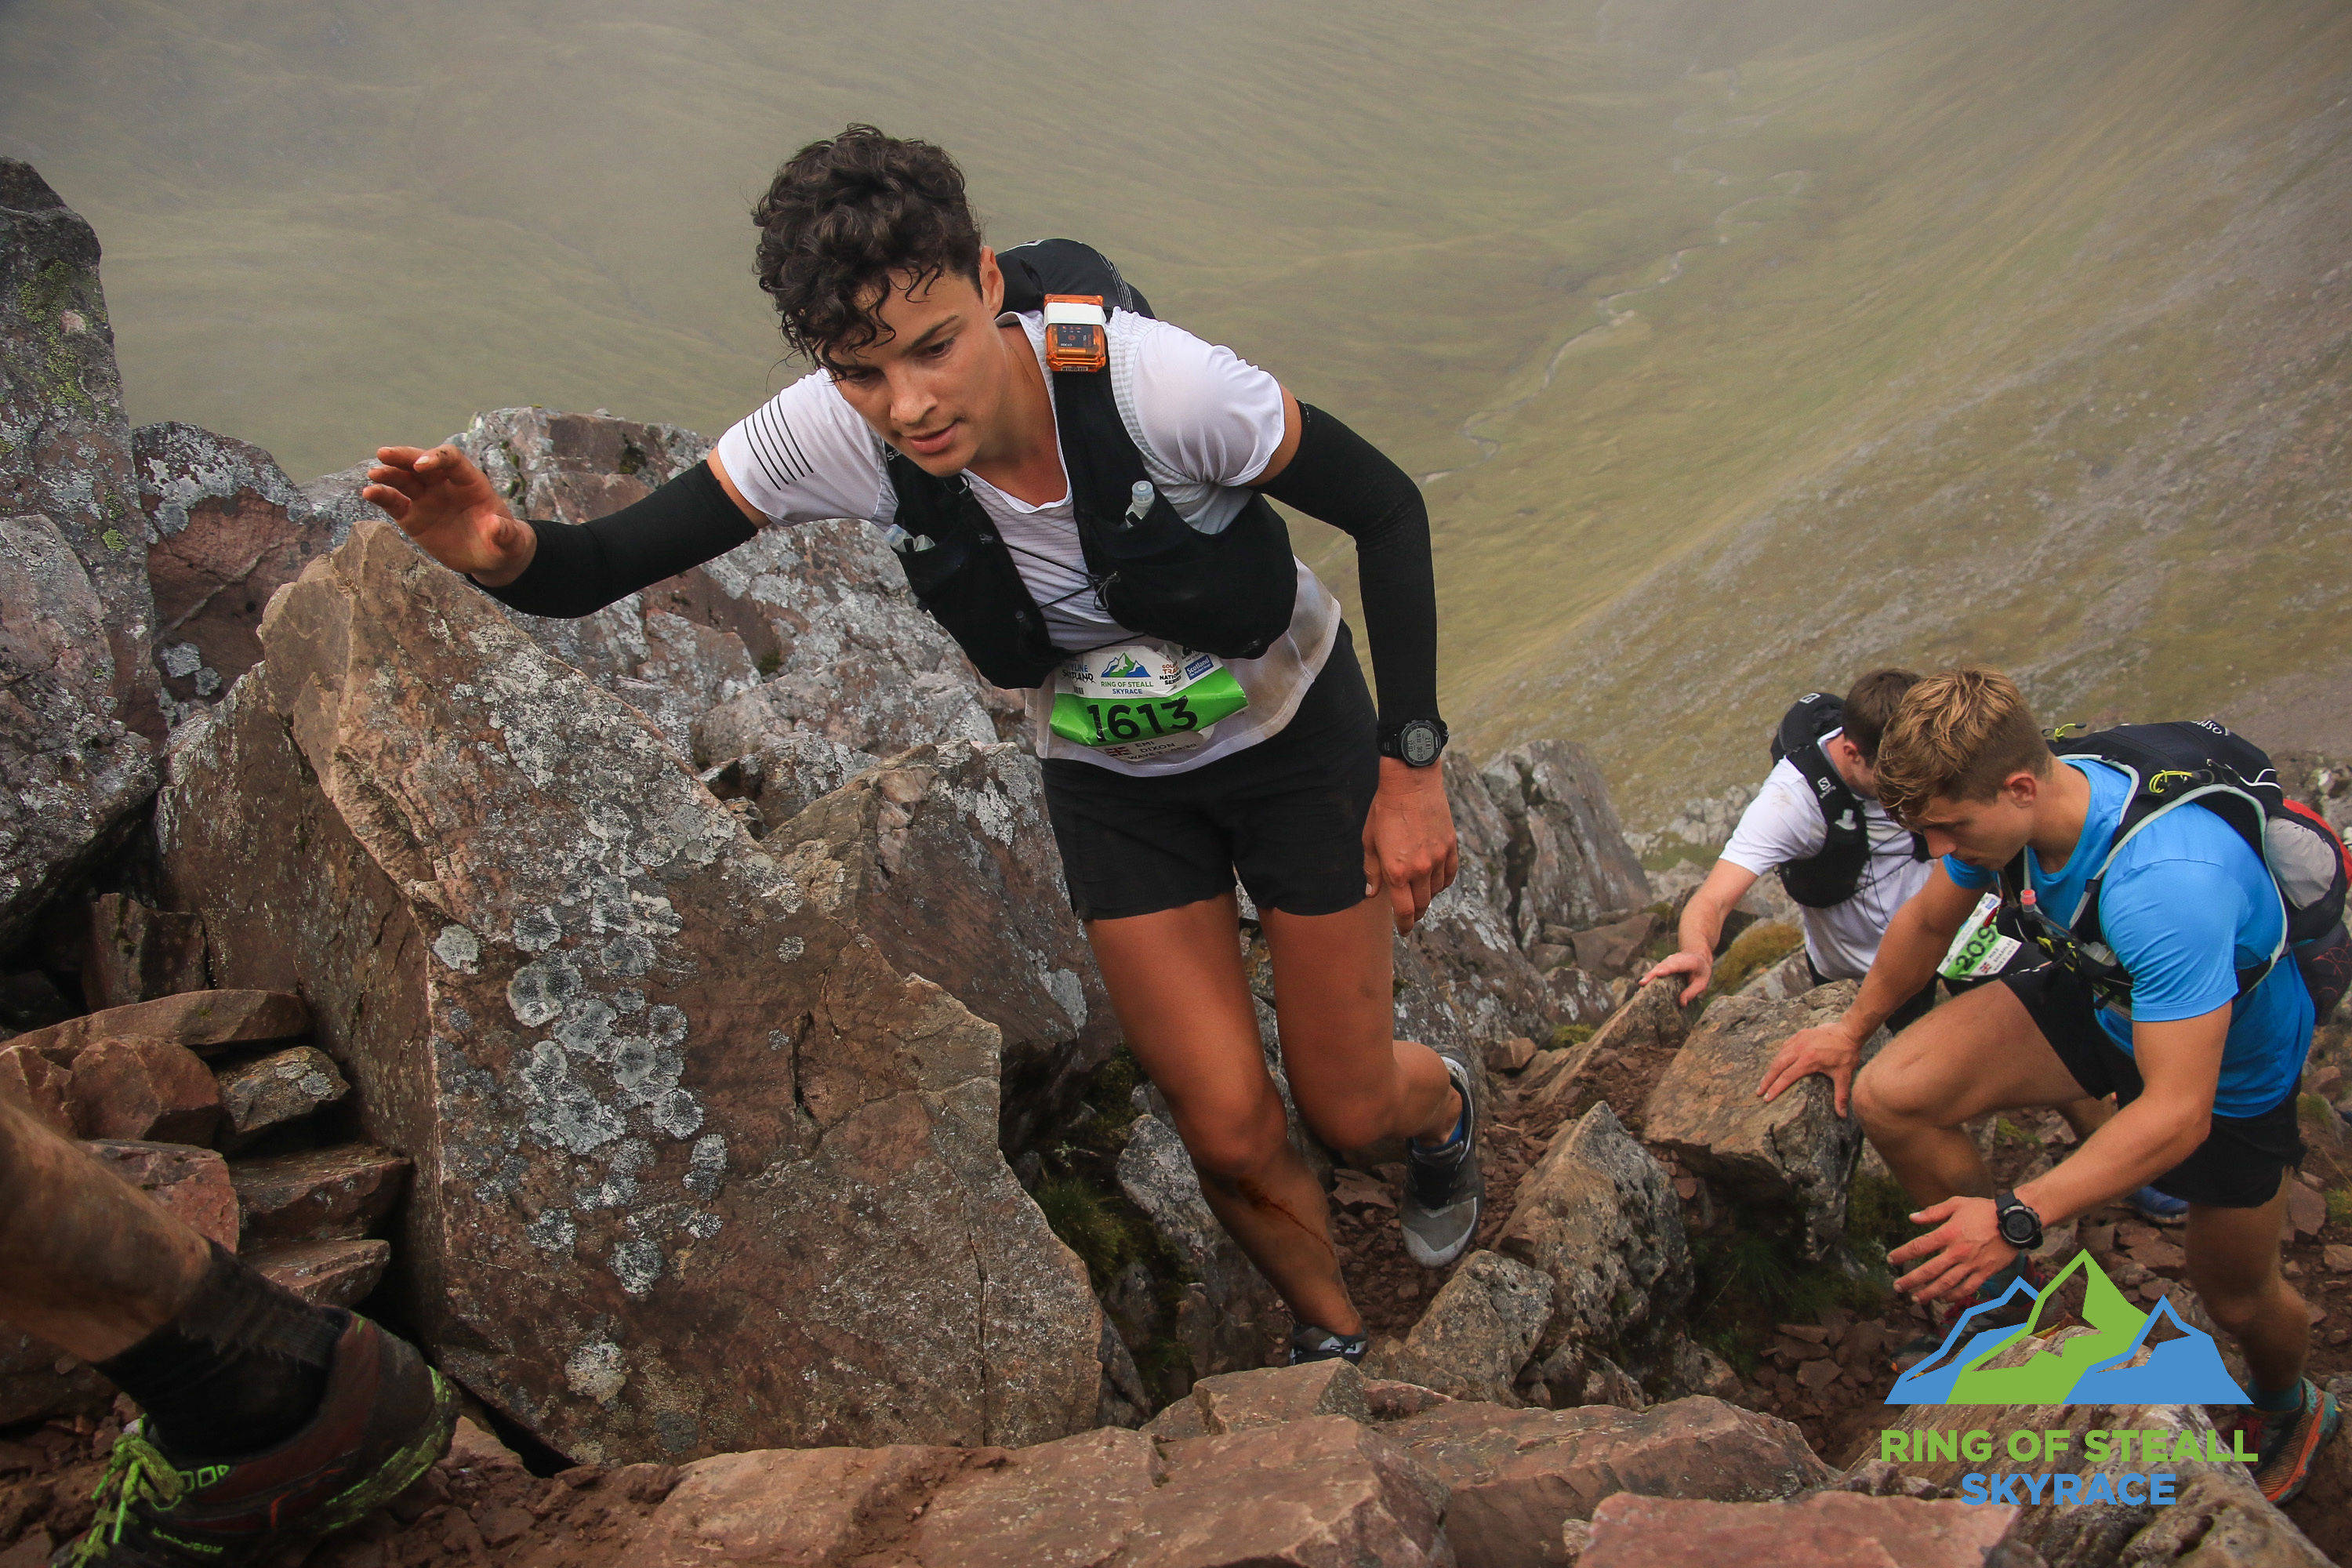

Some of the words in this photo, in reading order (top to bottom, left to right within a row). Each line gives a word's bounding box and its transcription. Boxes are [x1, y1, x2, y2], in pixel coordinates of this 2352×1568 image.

[1187, 657, 1210, 674] Scotland
[1087, 695, 1198, 742] 1613
[1140, 742, 1176, 753] DIXON
